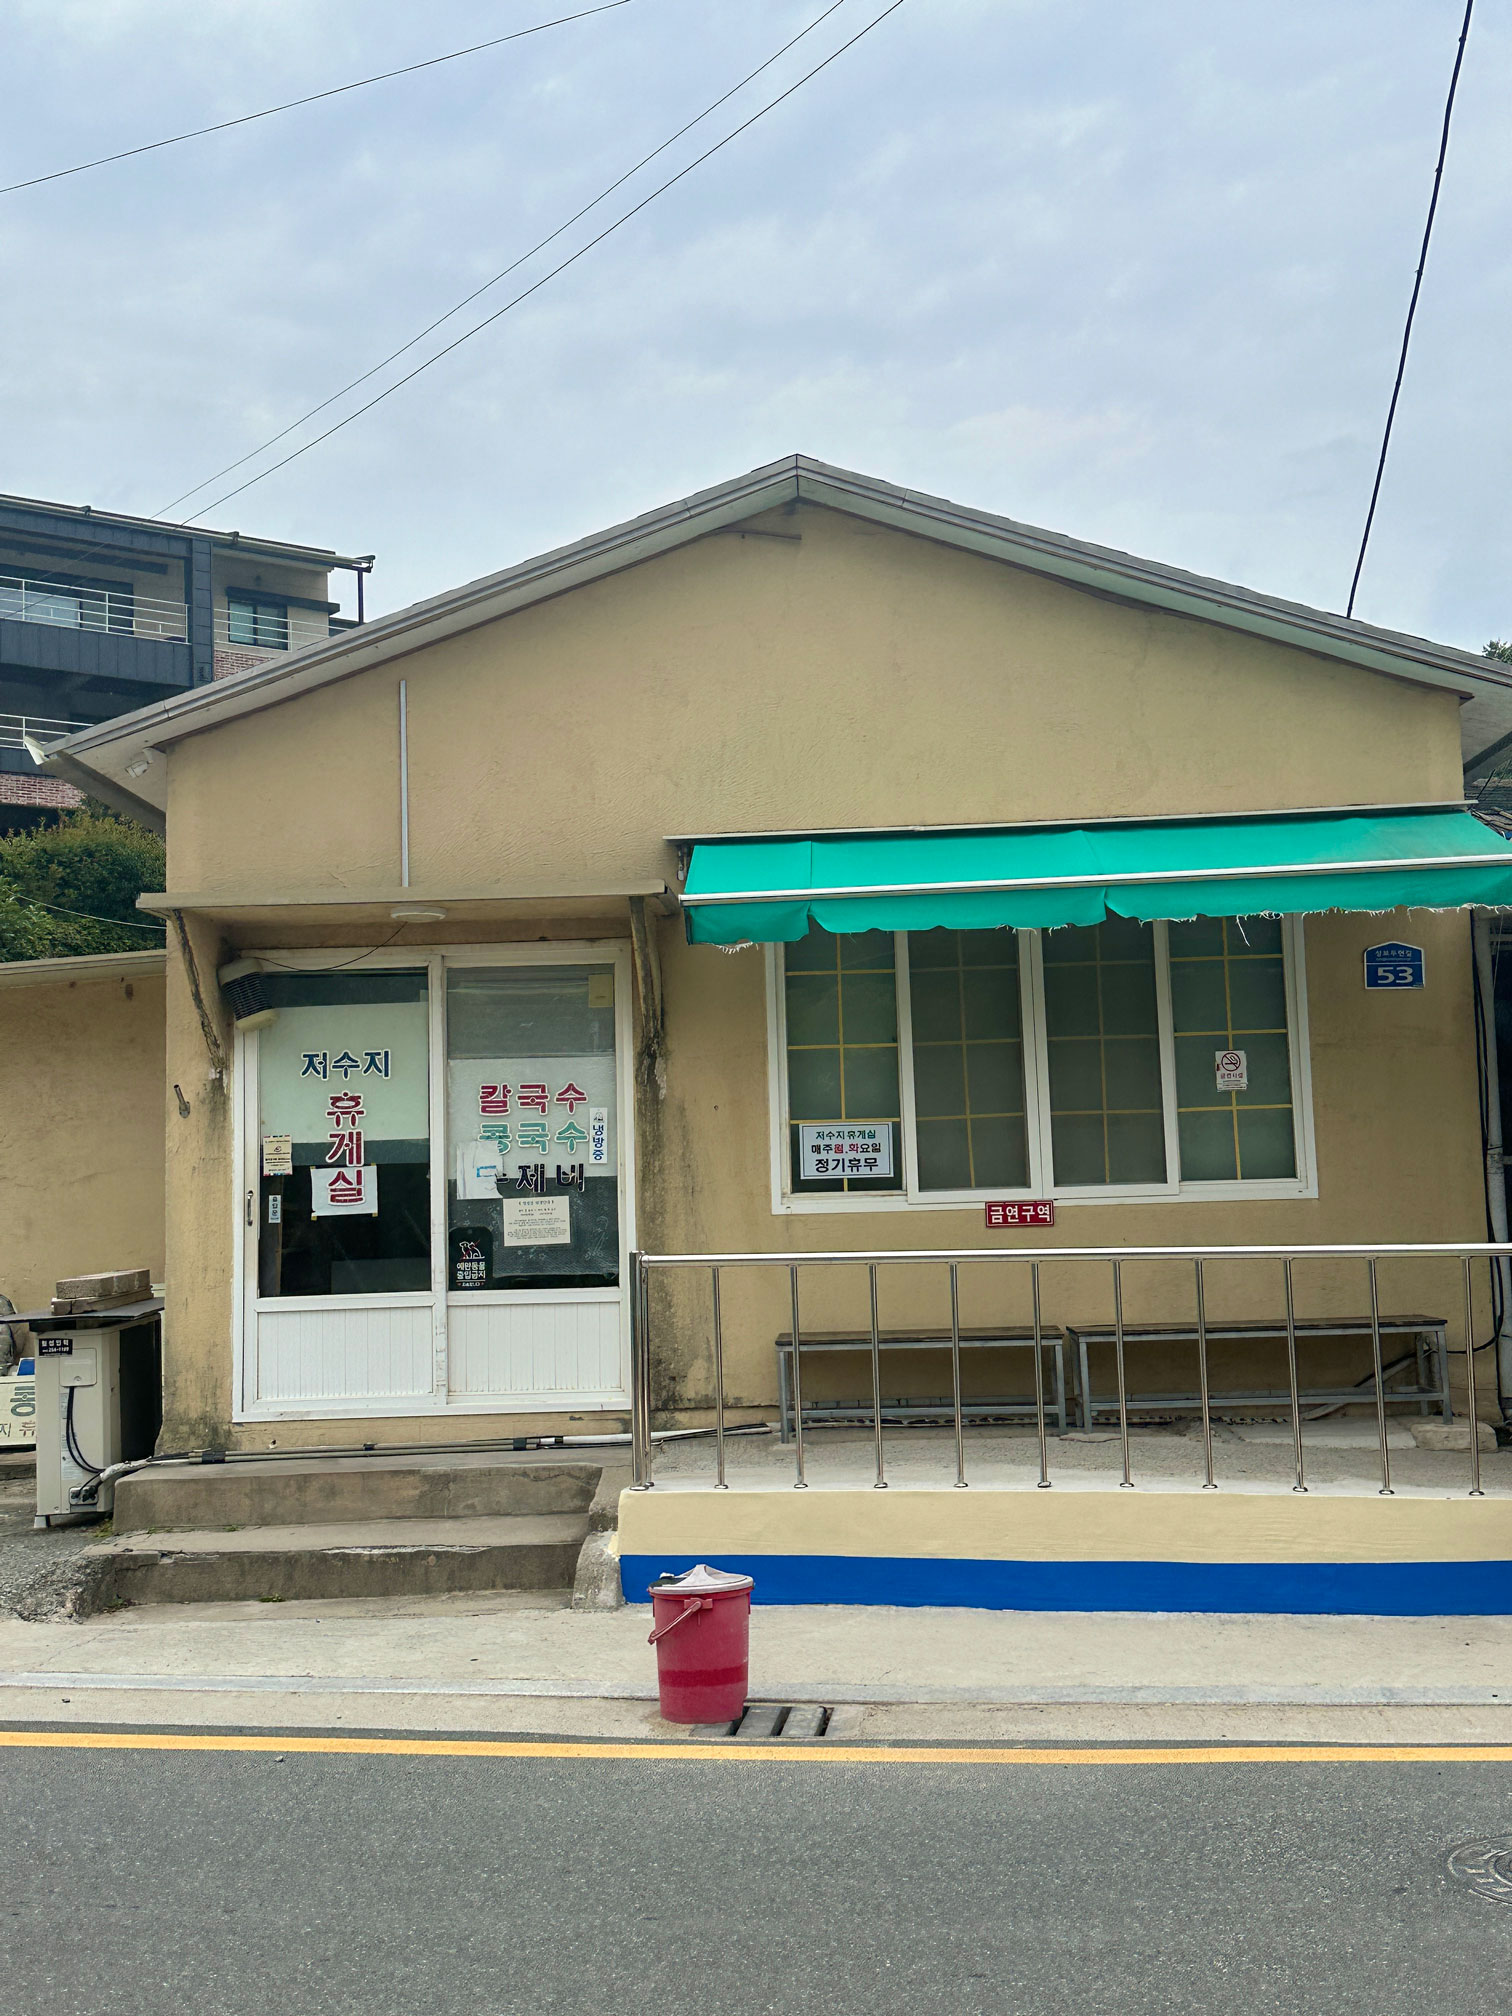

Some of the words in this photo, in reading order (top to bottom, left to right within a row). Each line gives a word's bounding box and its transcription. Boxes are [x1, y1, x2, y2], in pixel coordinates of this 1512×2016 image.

[1377, 966, 1413, 984] 53
[301, 1049, 390, 1080] 저수지
[479, 1082, 588, 1116] 칼국수
[325, 1091, 366, 1207] 휴게실
[478, 1121, 589, 1155] 콩국수
[592, 1124, 604, 1161] 냉방중
[496, 1163, 586, 1193] 제비
[815, 1157, 879, 1173] 정기휴무
[989, 1204, 1051, 1223] 금연구역
